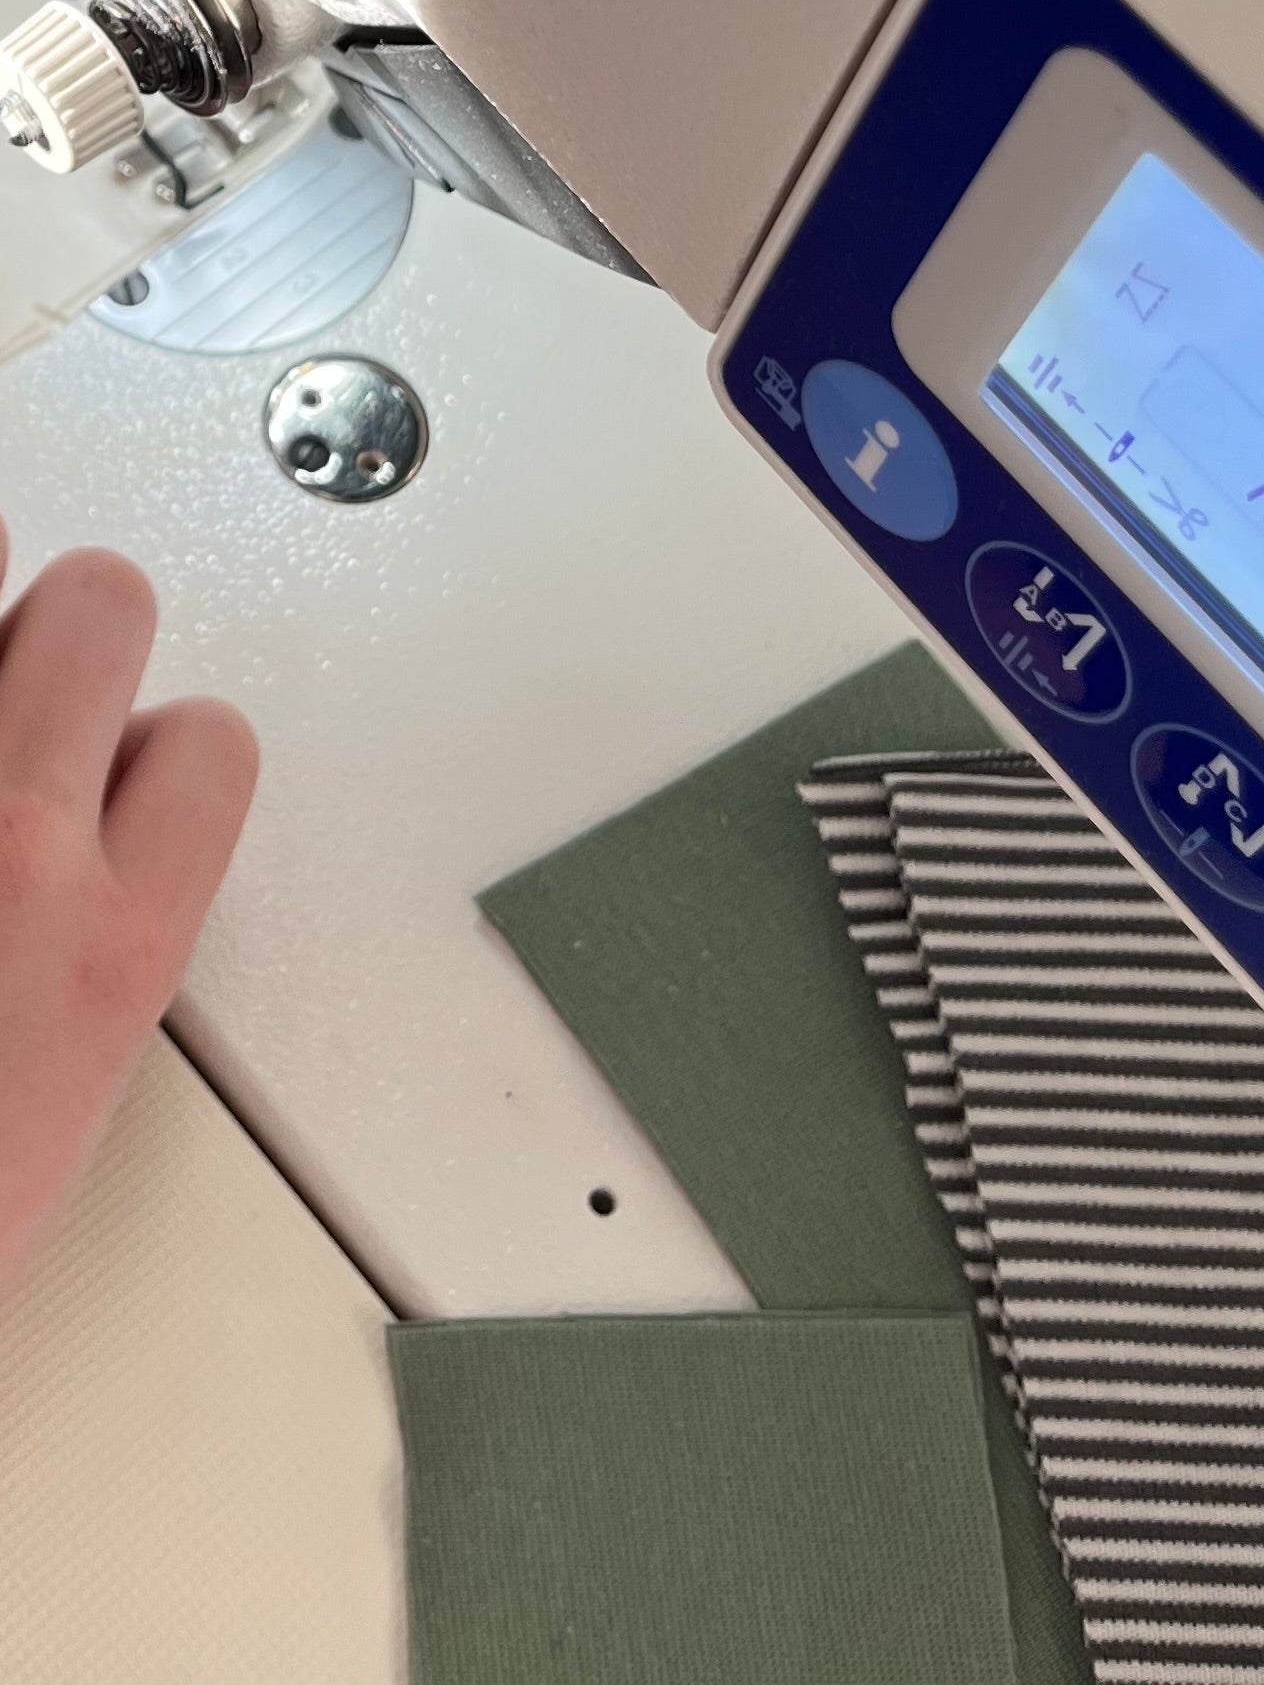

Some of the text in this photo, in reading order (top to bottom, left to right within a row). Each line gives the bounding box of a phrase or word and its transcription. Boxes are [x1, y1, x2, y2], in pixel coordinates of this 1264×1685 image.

[844, 419, 900, 493] i
[1018, 583, 1067, 632] A B
[1191, 764, 1249, 824] D C
